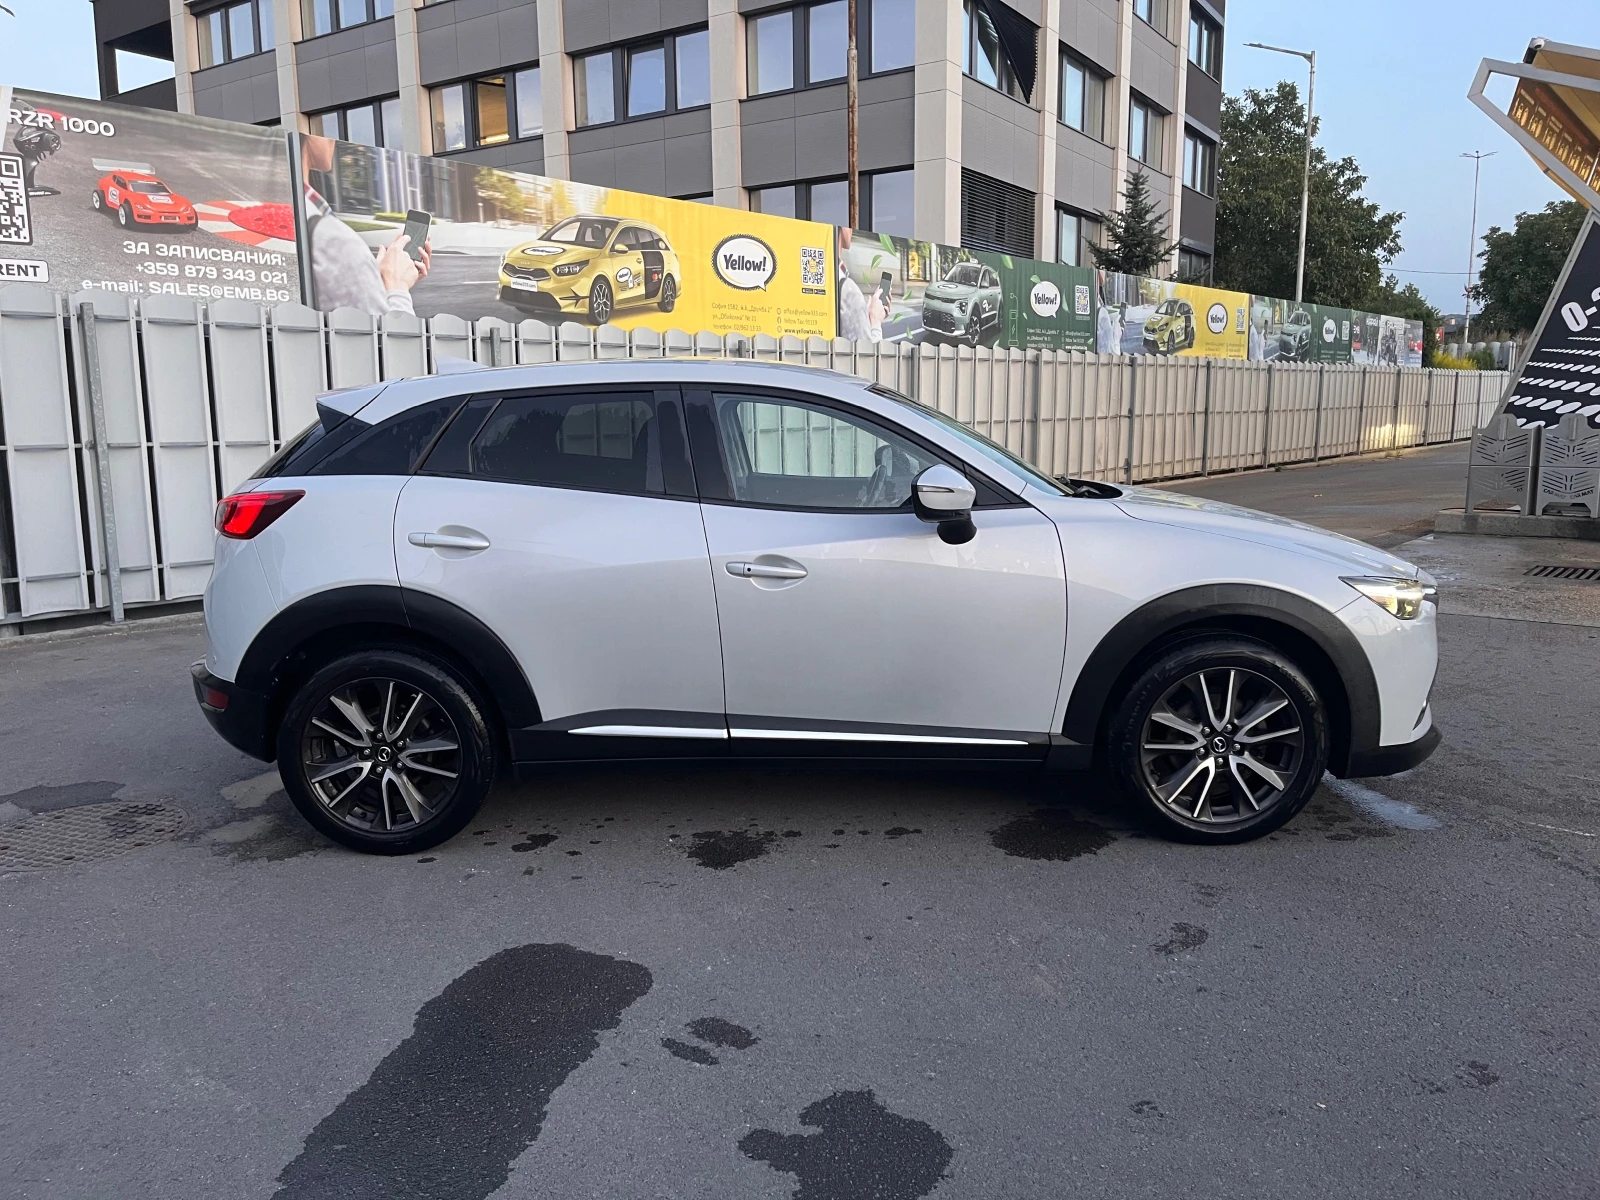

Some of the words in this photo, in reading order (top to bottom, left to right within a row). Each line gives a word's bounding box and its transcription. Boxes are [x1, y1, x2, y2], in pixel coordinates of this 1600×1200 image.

[8, 108, 55, 129] RZR
[60, 116, 115, 137] 1000
[122, 240, 149, 255] ЗА
[155, 243, 287, 266] ЗАПИСВАНИЯ:
[723, 253, 767, 272] Yellow!
[135, 262, 179, 276] +359
[184, 265, 218, 279] 879
[222, 267, 256, 282] 343
[260, 270, 288, 284] 021
[82, 279, 144, 293] e-mail:
[148, 281, 290, 301] SALES@EMB.BG
[1034, 292, 1058, 305] Yellow!
